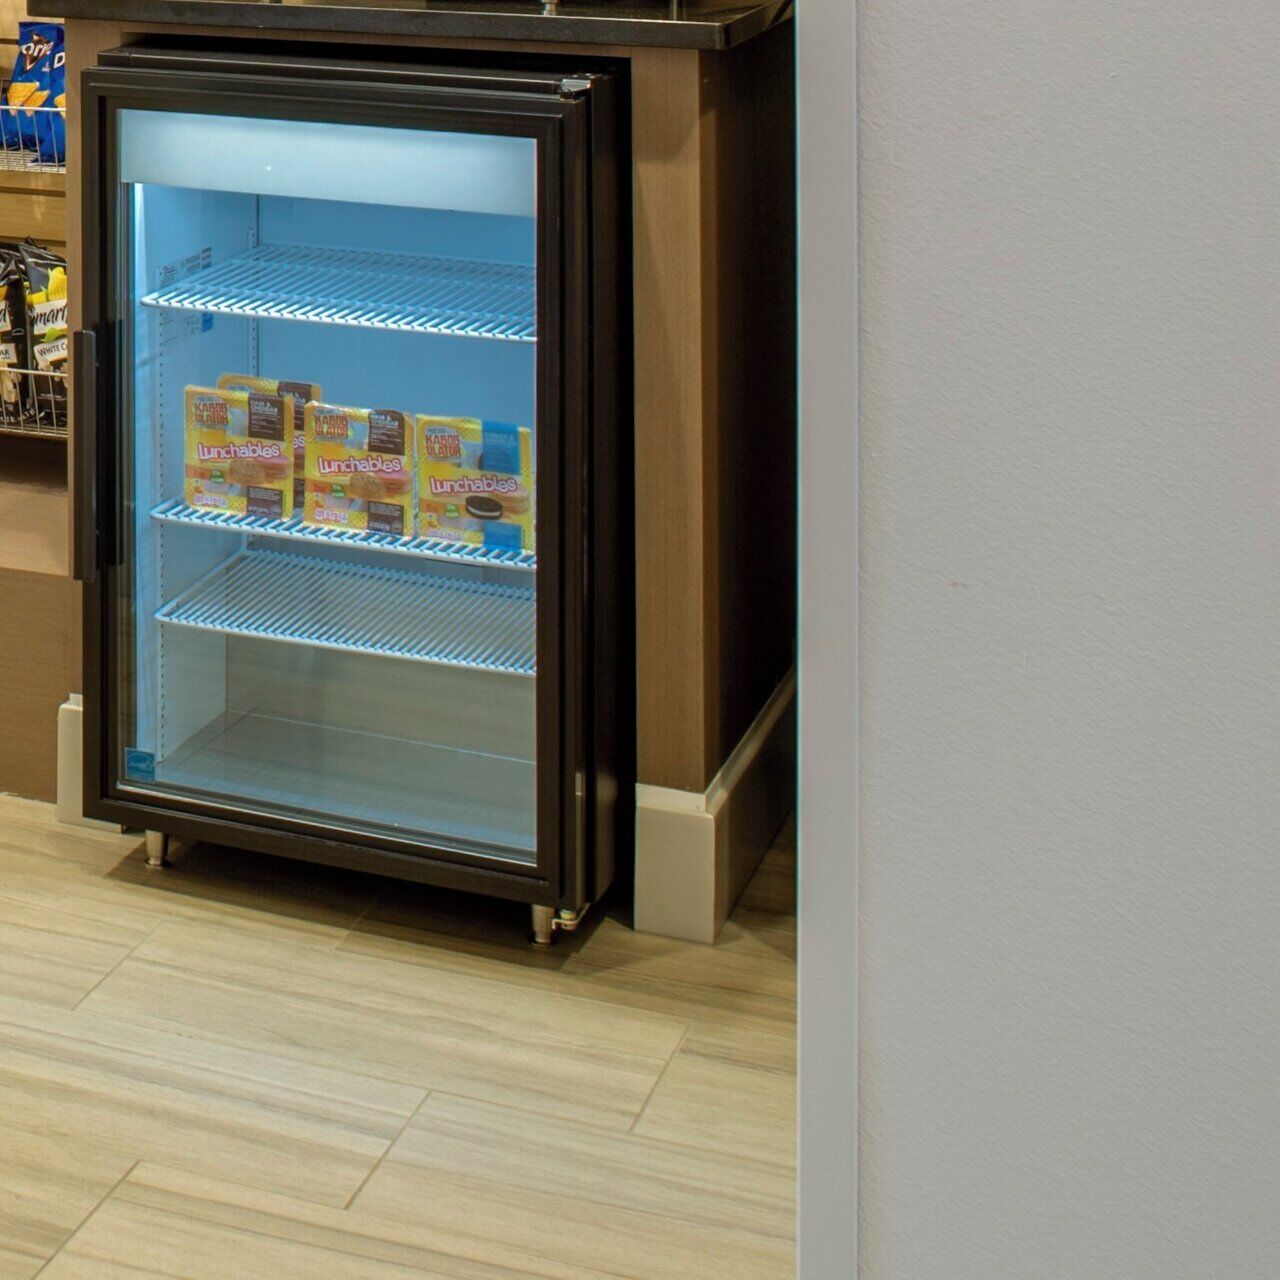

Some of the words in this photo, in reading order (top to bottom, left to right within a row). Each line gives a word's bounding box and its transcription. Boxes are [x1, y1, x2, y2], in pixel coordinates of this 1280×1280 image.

[37, 345, 61, 358] WHITE
[425, 434, 460, 446] KABOB
[198, 441, 281, 461] Lunchables
[318, 455, 402, 475] Lunchables
[430, 474, 517, 495] Lunchables
